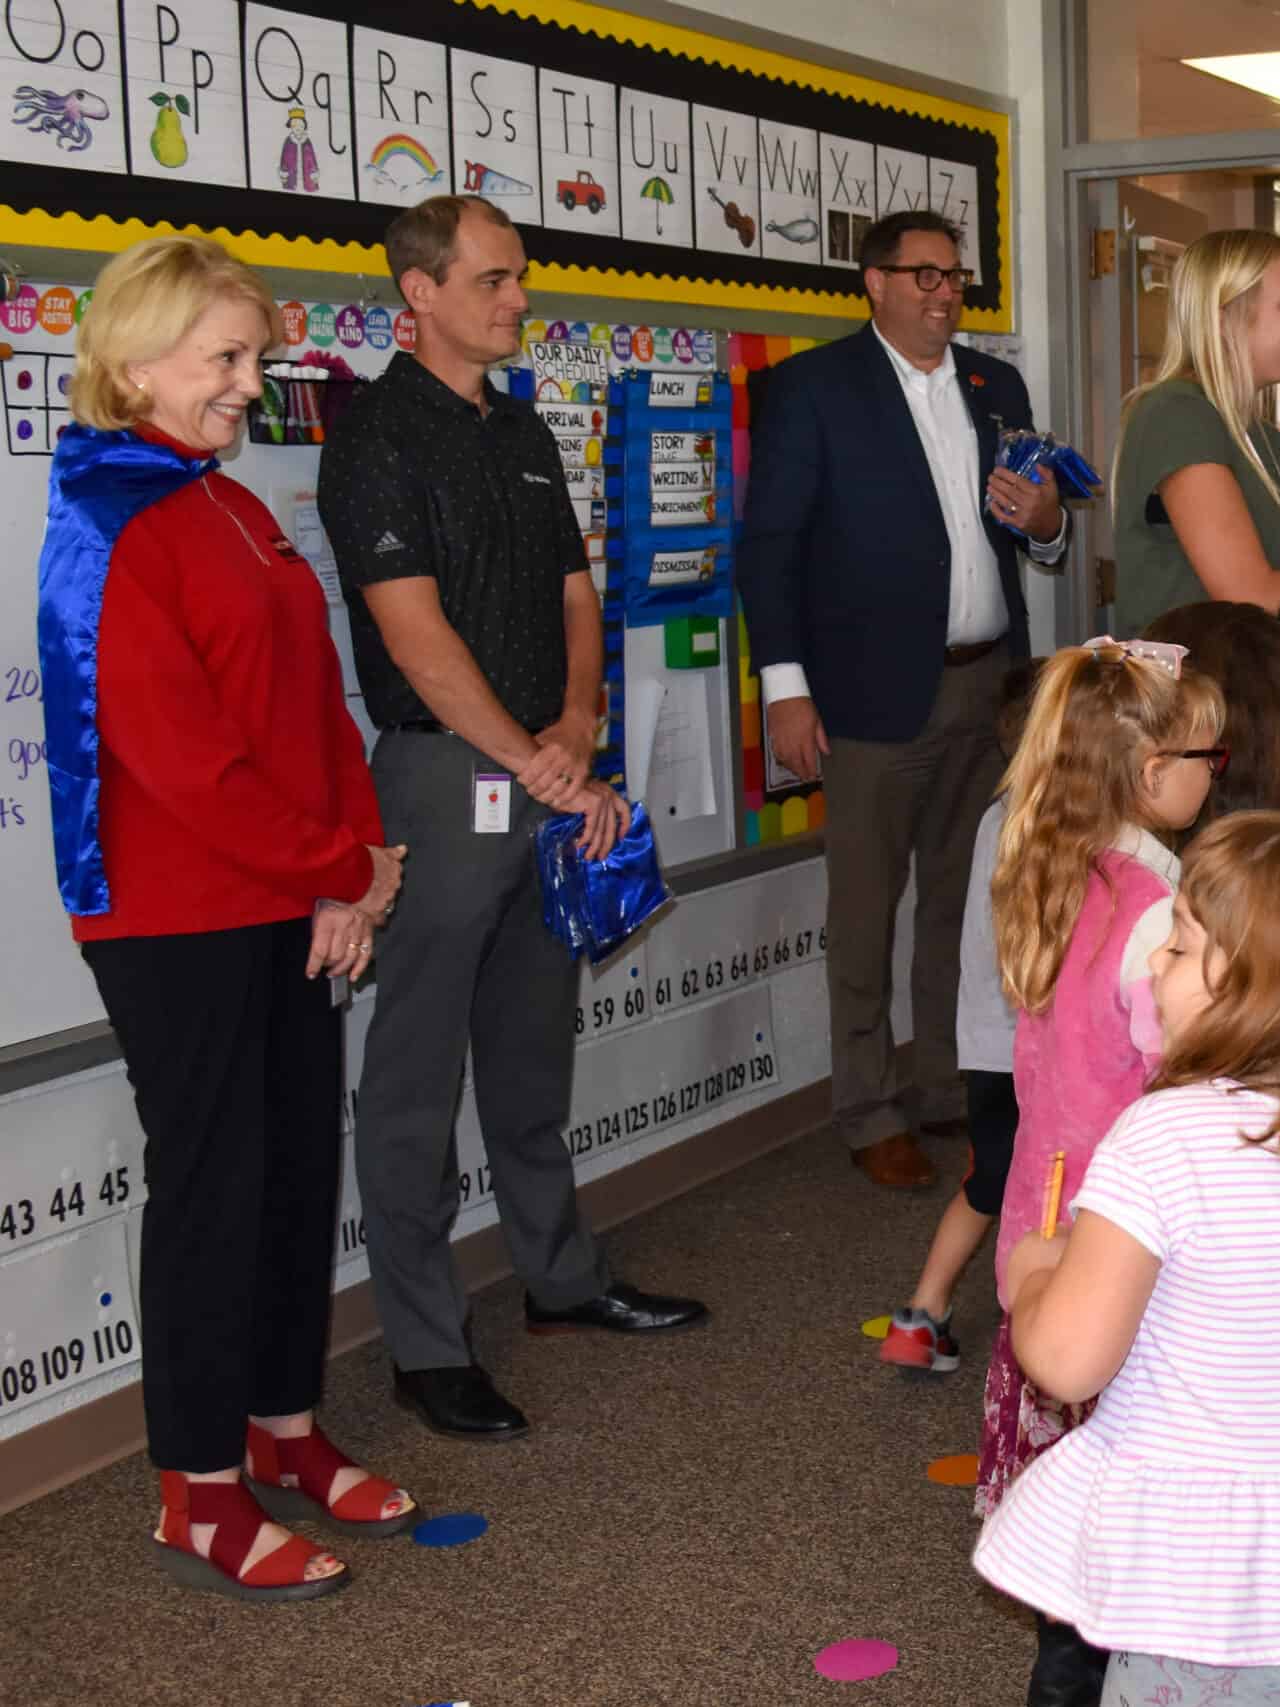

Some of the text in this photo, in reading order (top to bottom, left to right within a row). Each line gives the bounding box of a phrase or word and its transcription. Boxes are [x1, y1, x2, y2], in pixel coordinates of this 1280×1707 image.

[6, 0, 105, 72] Oo
[156, 4, 214, 135] Pp
[254, 26, 347, 156] Qq
[376, 49, 433, 123] Rr
[470, 71, 517, 143] Ss
[551, 87, 595, 159] Tt
[630, 104, 678, 174] Uu
[705, 121, 748, 185] Vv
[761, 134, 818, 199] Ww
[830, 147, 867, 208] Xx
[938, 171, 969, 227] Zz
[8, 310, 32, 329] BIG
[45, 296, 72, 311] STAY
[339, 326, 361, 342] KIND
[535, 344, 601, 365] OUR DAILY
[535, 361, 606, 384] SCHEDULE
[651, 382, 685, 396] LUNCH
[654, 435, 685, 450] STORY
[652, 501, 701, 513] ENRICHMENT
[653, 471, 699, 486] WRITING
[653, 560, 699, 574] DISMISSAL
[593, 997, 615, 1029] 59
[624, 988, 645, 1019] 60
[655, 977, 672, 1005] 61
[681, 969, 699, 998] 62
[705, 960, 724, 989] 63
[730, 952, 748, 981] 64
[753, 945, 769, 973] 65
[774, 937, 790, 965] 66
[795, 930, 813, 957] 67
[569, 1053, 774, 1157] 123 124 125 126 127 128 129 130
[0, 1199, 35, 1241] 43
[49, 1182, 85, 1223] 44
[99, 1166, 130, 1207] 45
[0, 1358, 38, 1404] 08
[41, 1337, 85, 1387] 109
[92, 1319, 134, 1365] 110
